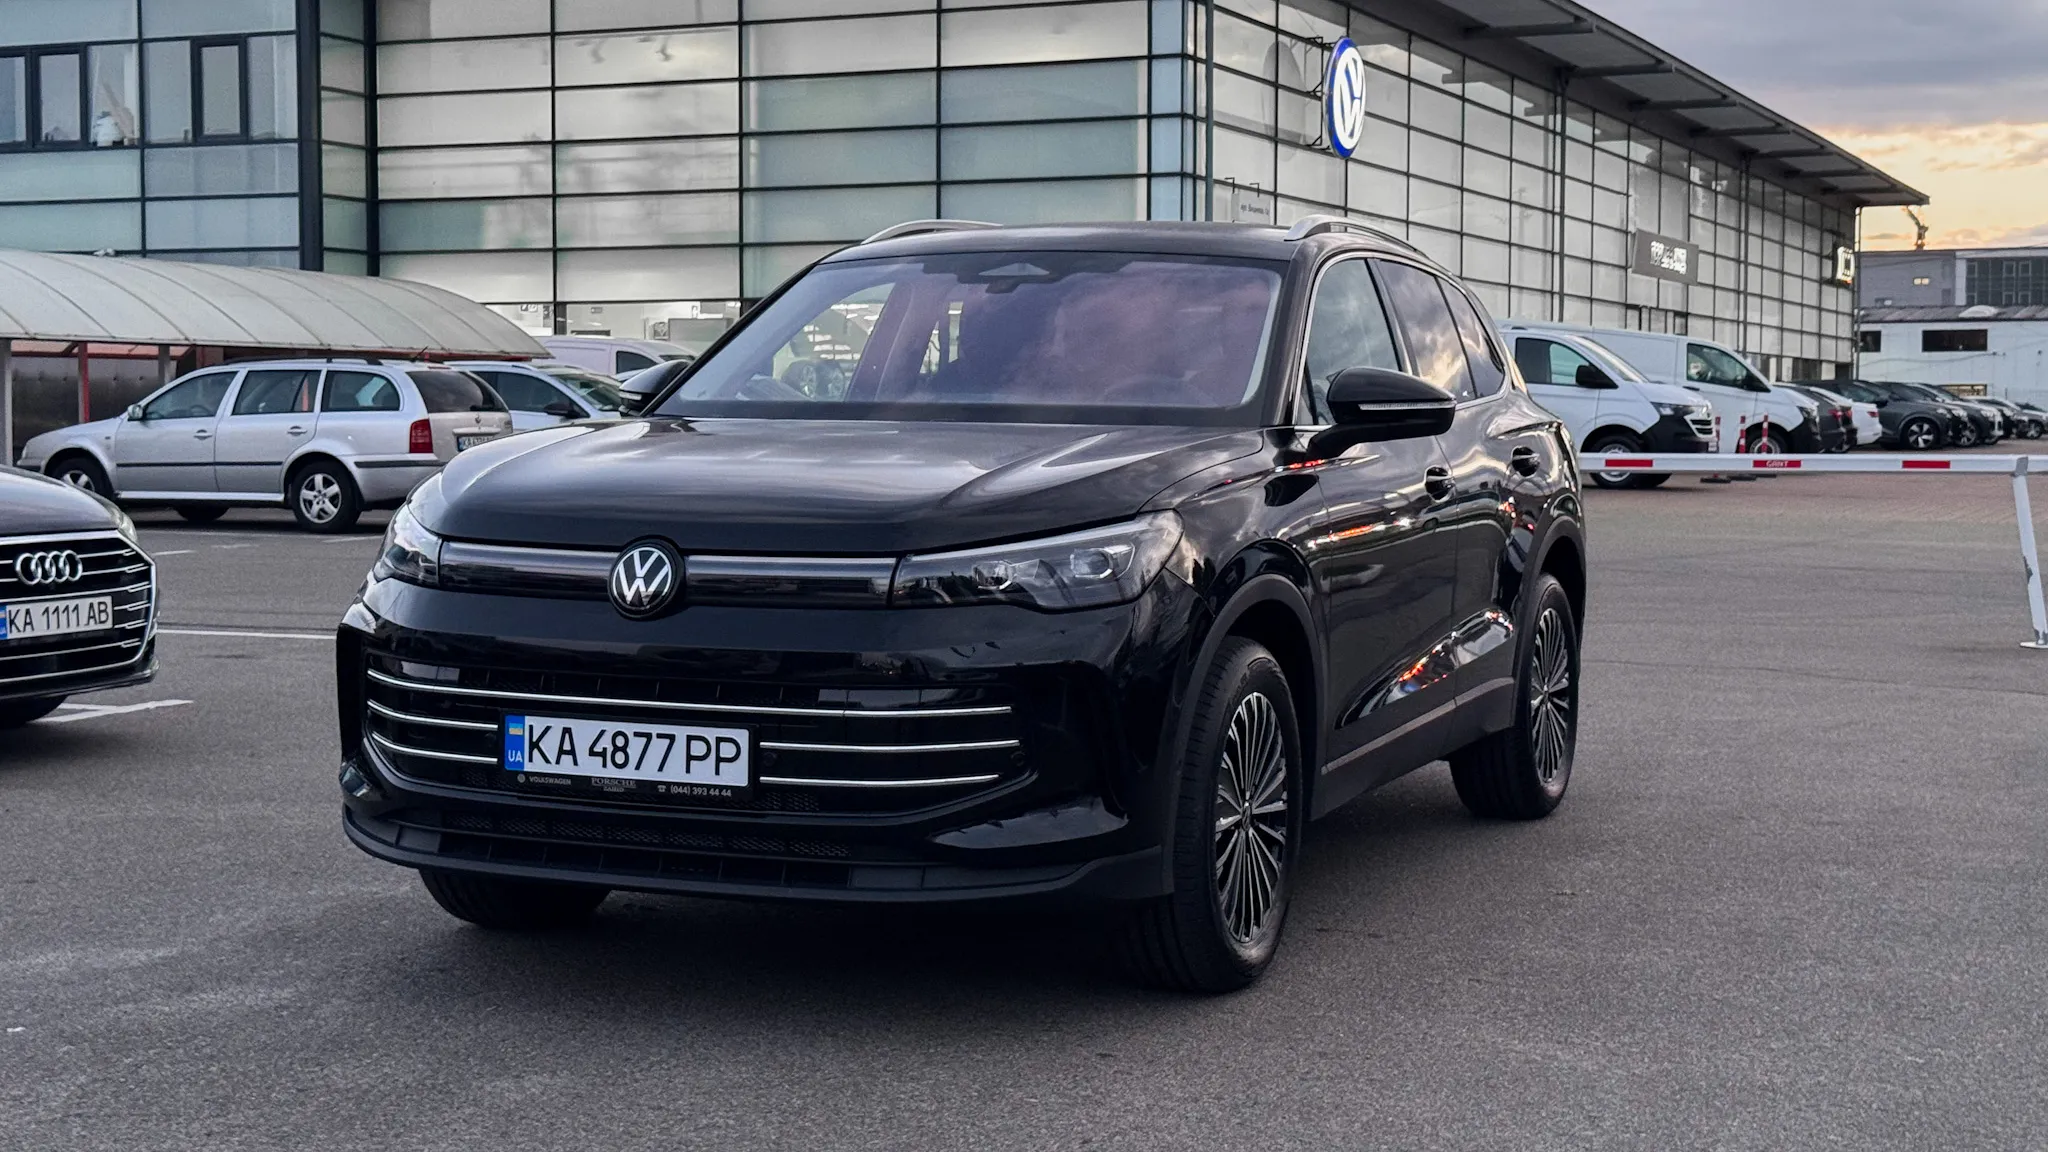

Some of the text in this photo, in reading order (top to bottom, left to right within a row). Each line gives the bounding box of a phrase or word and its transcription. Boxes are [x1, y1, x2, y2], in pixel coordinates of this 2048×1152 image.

[8, 601, 110, 634] KA 1111 AB
[508, 750, 523, 762] UA
[528, 724, 742, 776] KA 4877 PP
[529, 776, 572, 786] VOLKSWAGEN
[591, 777, 636, 787] PORSCHE
[670, 784, 732, 797] (044) 393 44 44
